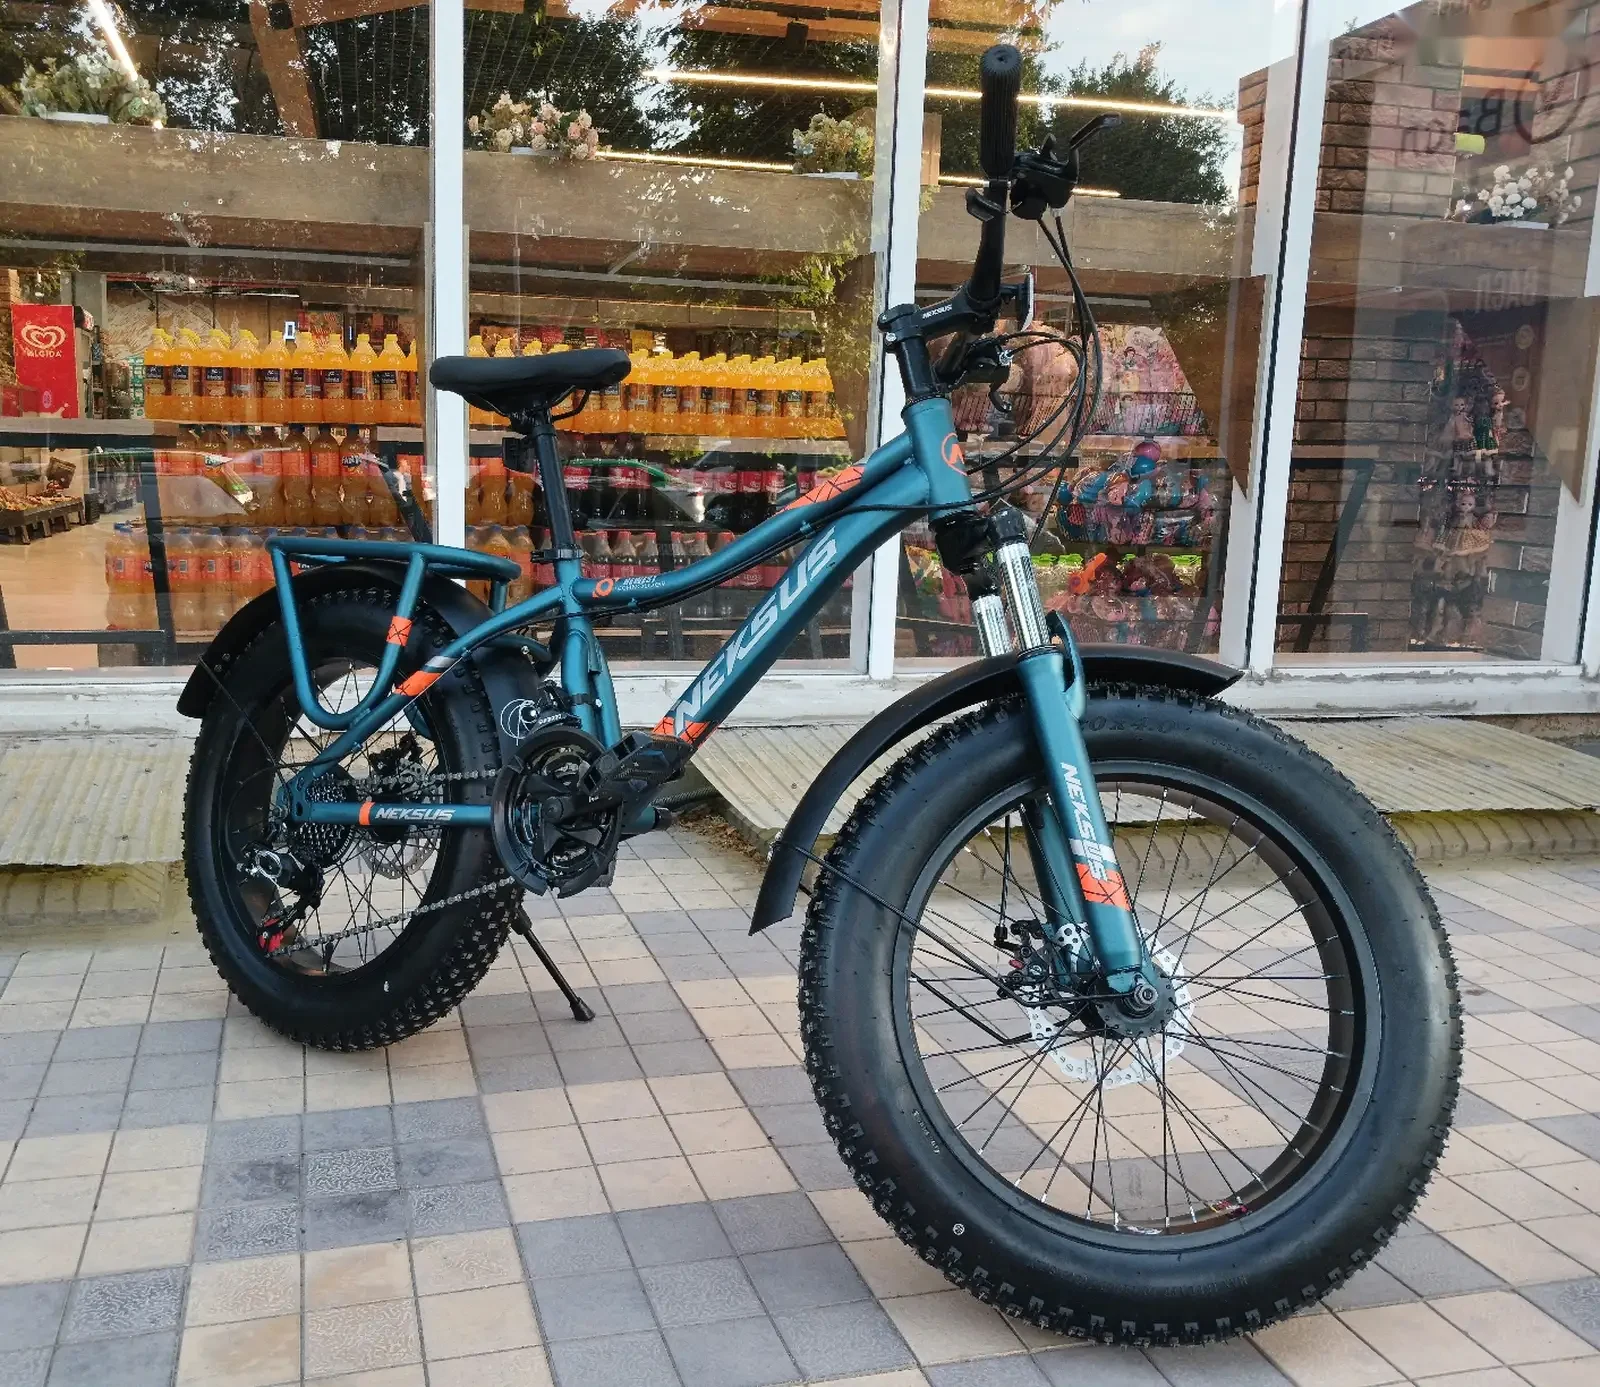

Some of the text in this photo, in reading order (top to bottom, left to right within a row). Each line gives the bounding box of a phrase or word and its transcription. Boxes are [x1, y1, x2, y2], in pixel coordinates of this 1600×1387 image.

[674, 526, 838, 738] NEKSUS
[374, 807, 456, 821] NEKSUS
[1060, 761, 1108, 882] NEKSUS
